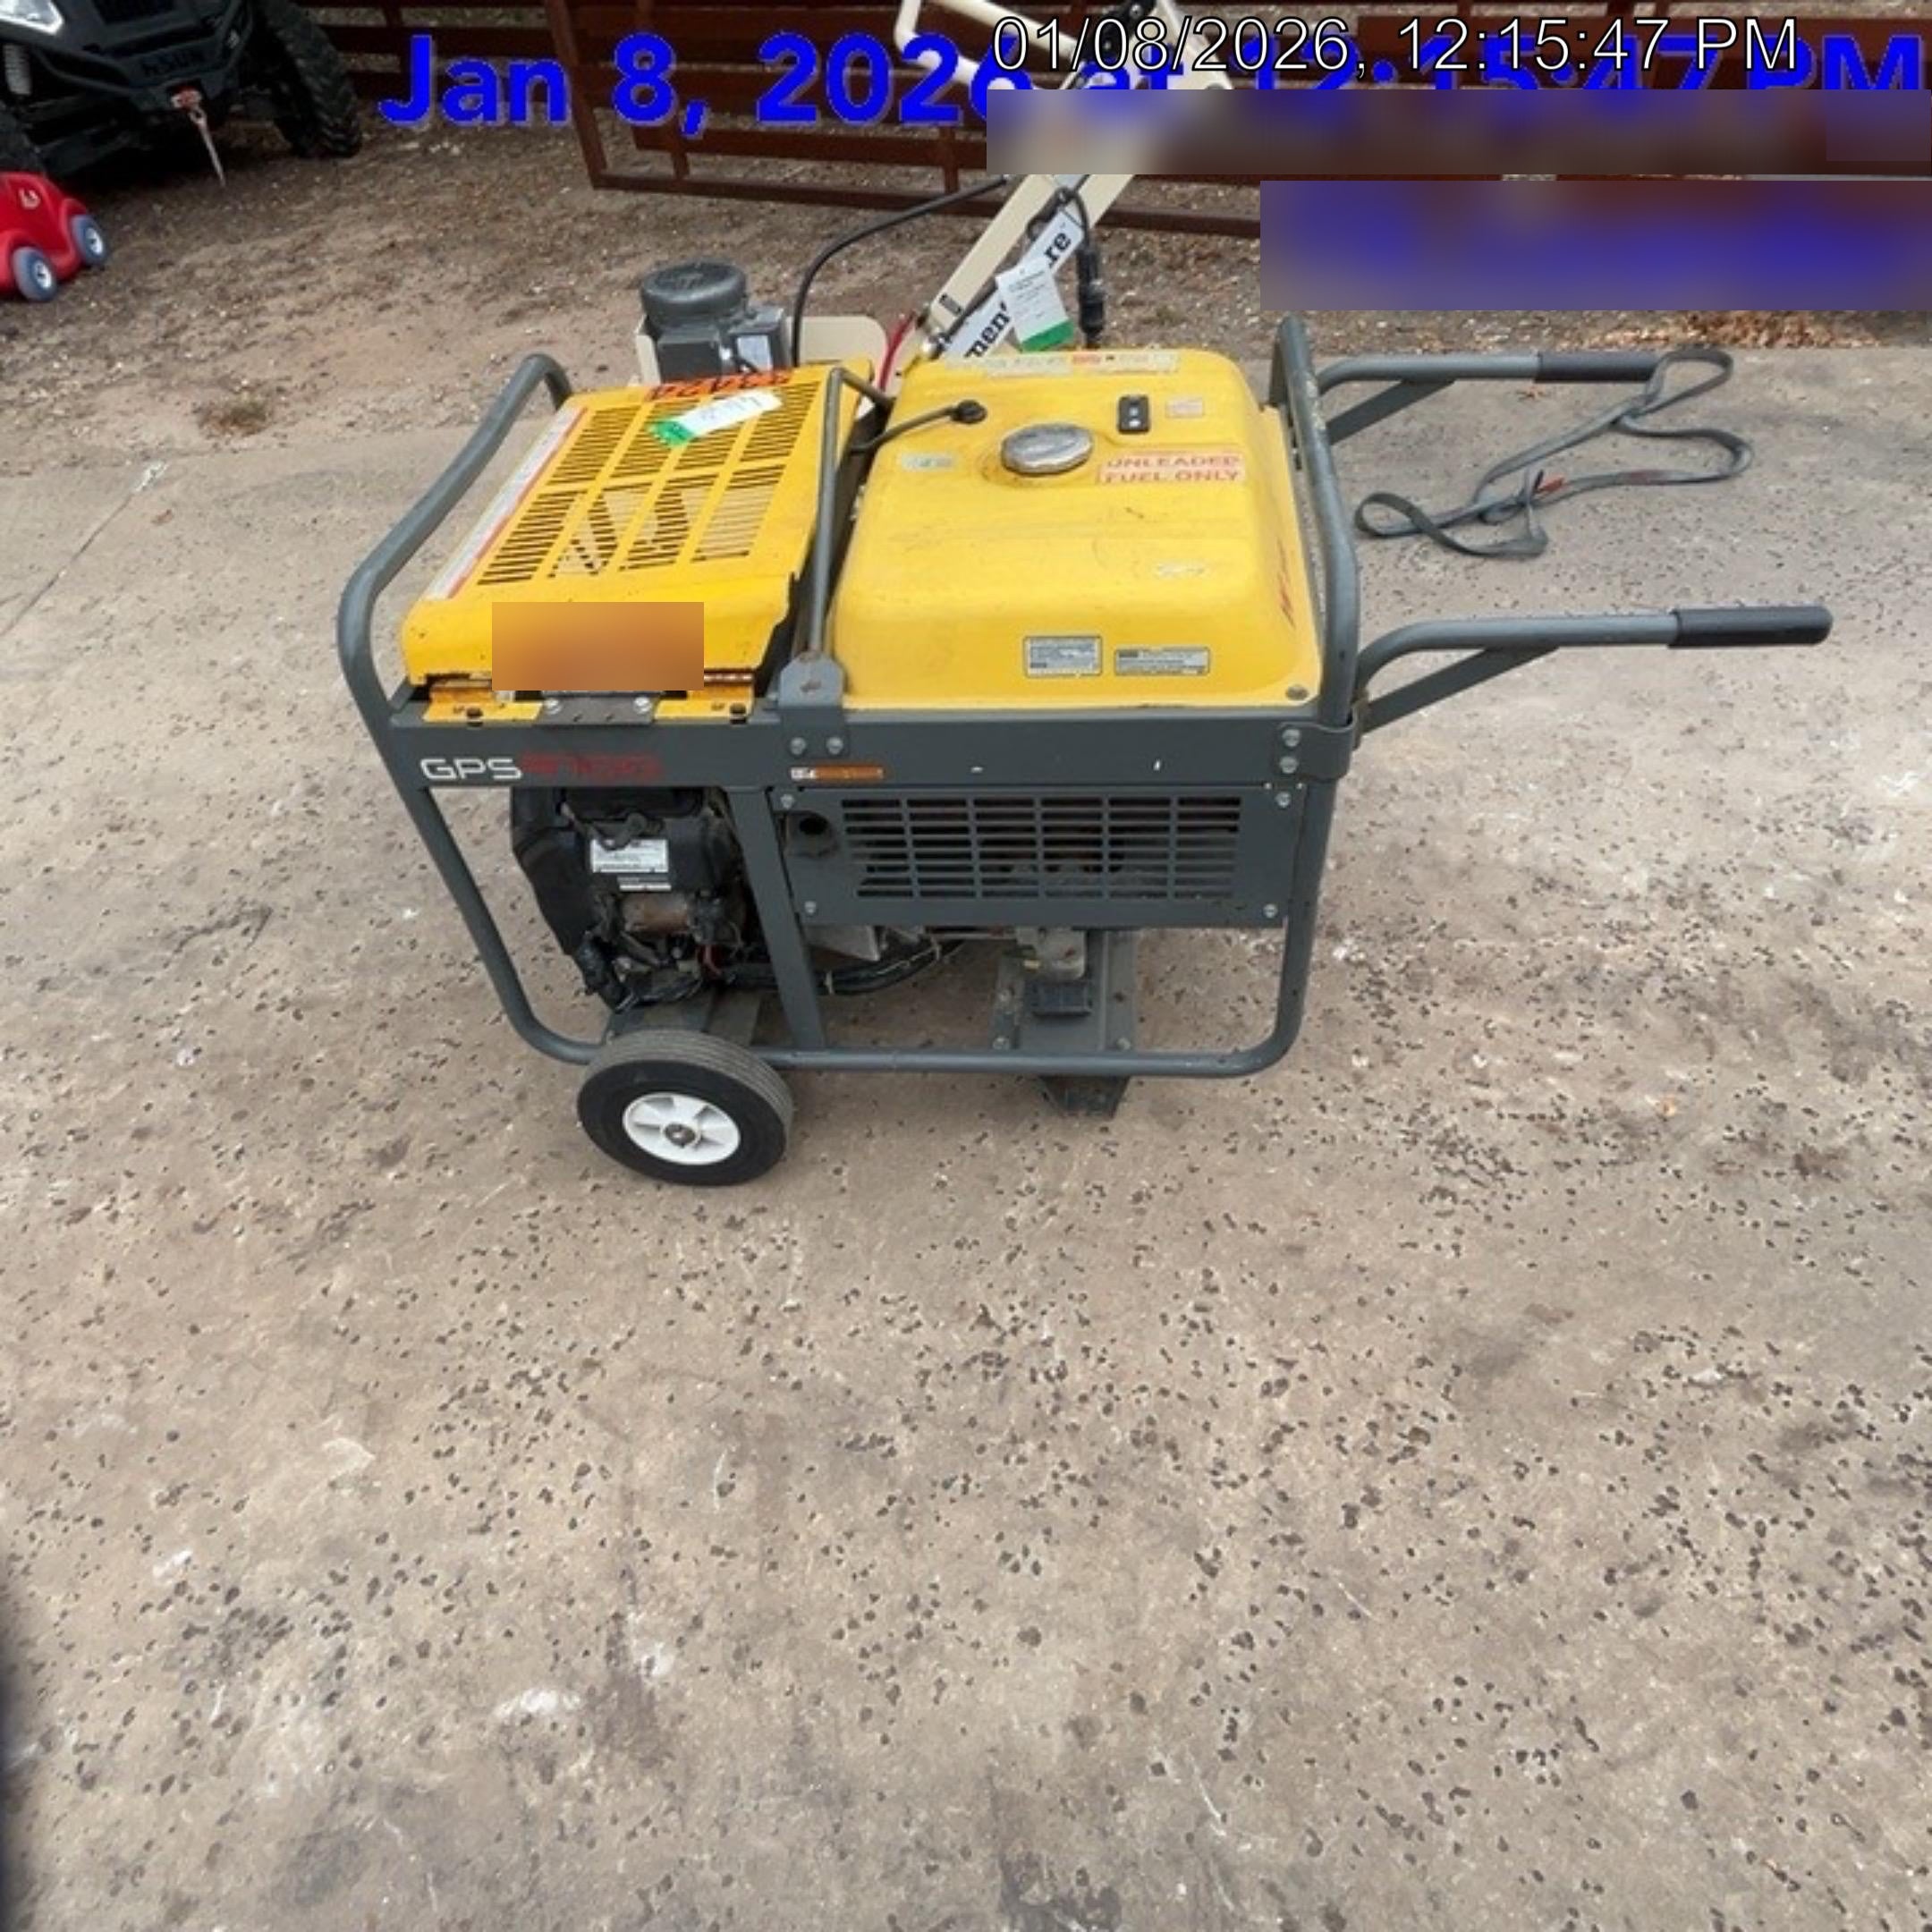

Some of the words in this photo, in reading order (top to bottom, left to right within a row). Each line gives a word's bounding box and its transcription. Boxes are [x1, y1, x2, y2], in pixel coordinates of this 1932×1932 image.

[1106, 455, 1239, 468] UNLEADED
[1105, 471, 1165, 484] FUEL
[1174, 470, 1239, 482] ONLY
